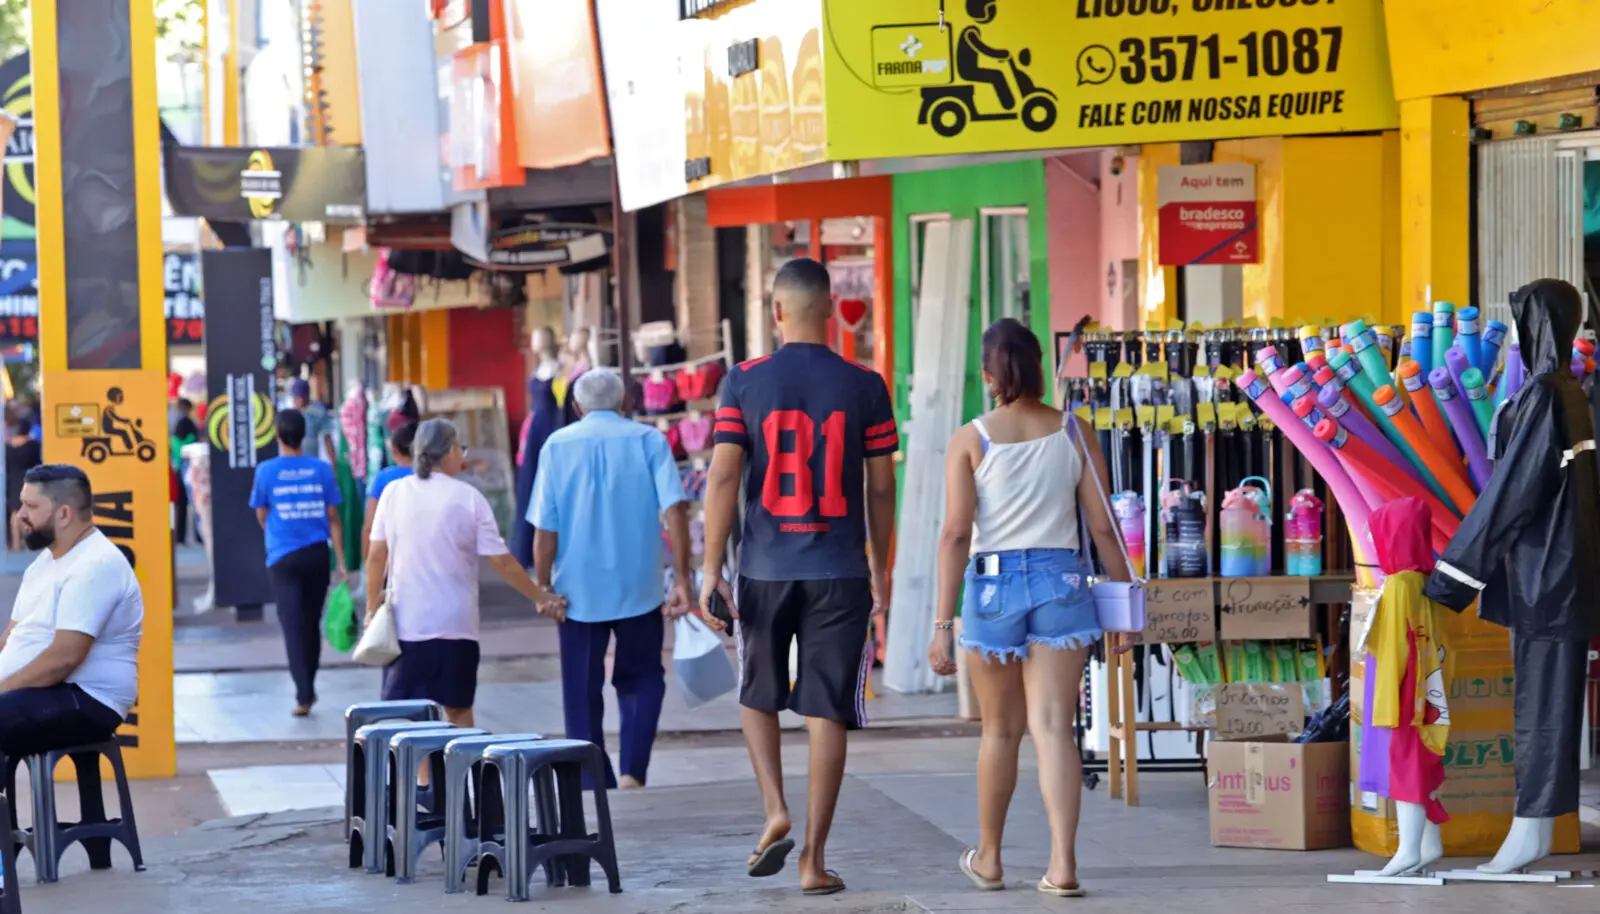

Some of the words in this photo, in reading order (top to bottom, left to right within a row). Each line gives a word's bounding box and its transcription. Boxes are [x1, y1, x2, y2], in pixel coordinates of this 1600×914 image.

[1119, 26, 1343, 85] 3571-1087
[1079, 103, 1126, 127] FALE
[1132, 99, 1182, 125] COM
[1188, 95, 1261, 122] NOSSA
[1268, 90, 1344, 119] EQUIPE
[1181, 176, 1212, 189] Aqui
[1216, 176, 1244, 187] tem
[1180, 207, 1244, 220] bradesco
[762, 410, 847, 517] 81
